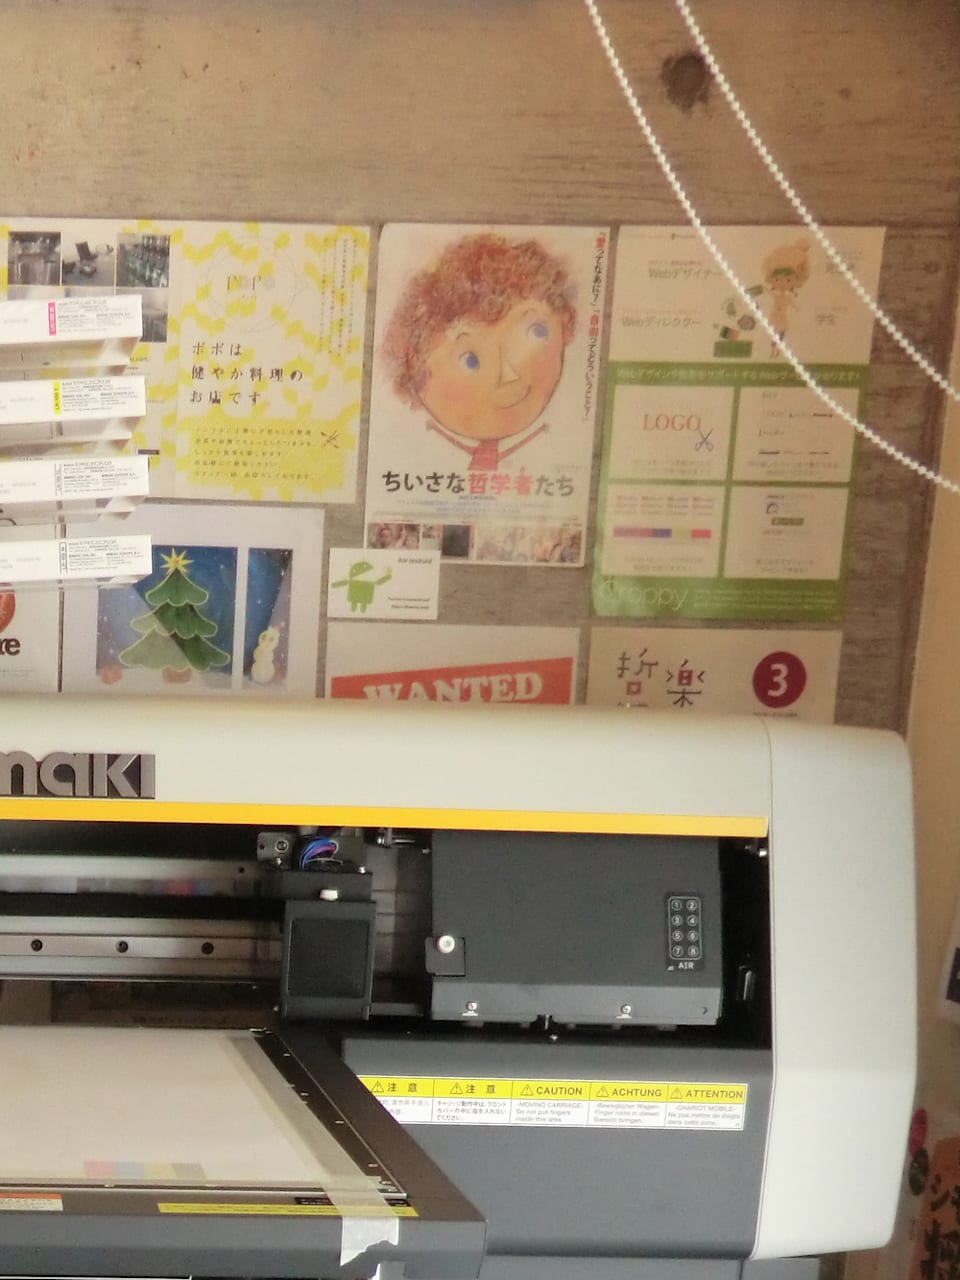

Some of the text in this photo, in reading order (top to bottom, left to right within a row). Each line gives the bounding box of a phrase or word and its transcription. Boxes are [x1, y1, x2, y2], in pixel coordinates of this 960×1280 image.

[642, 413, 702, 432] LOGO
[381, 470, 575, 496] ちいさな哲学者たち
[767, 663, 789, 697] 3
[363, 672, 543, 703] WANTED
[387, 1082, 418, 1092] 注意
[465, 1084, 496, 1094] 注意
[536, 1086, 583, 1095] CAUTION
[611, 1088, 662, 1097] ACHTUNG
[685, 1090, 743, 1098] ATTENTION
